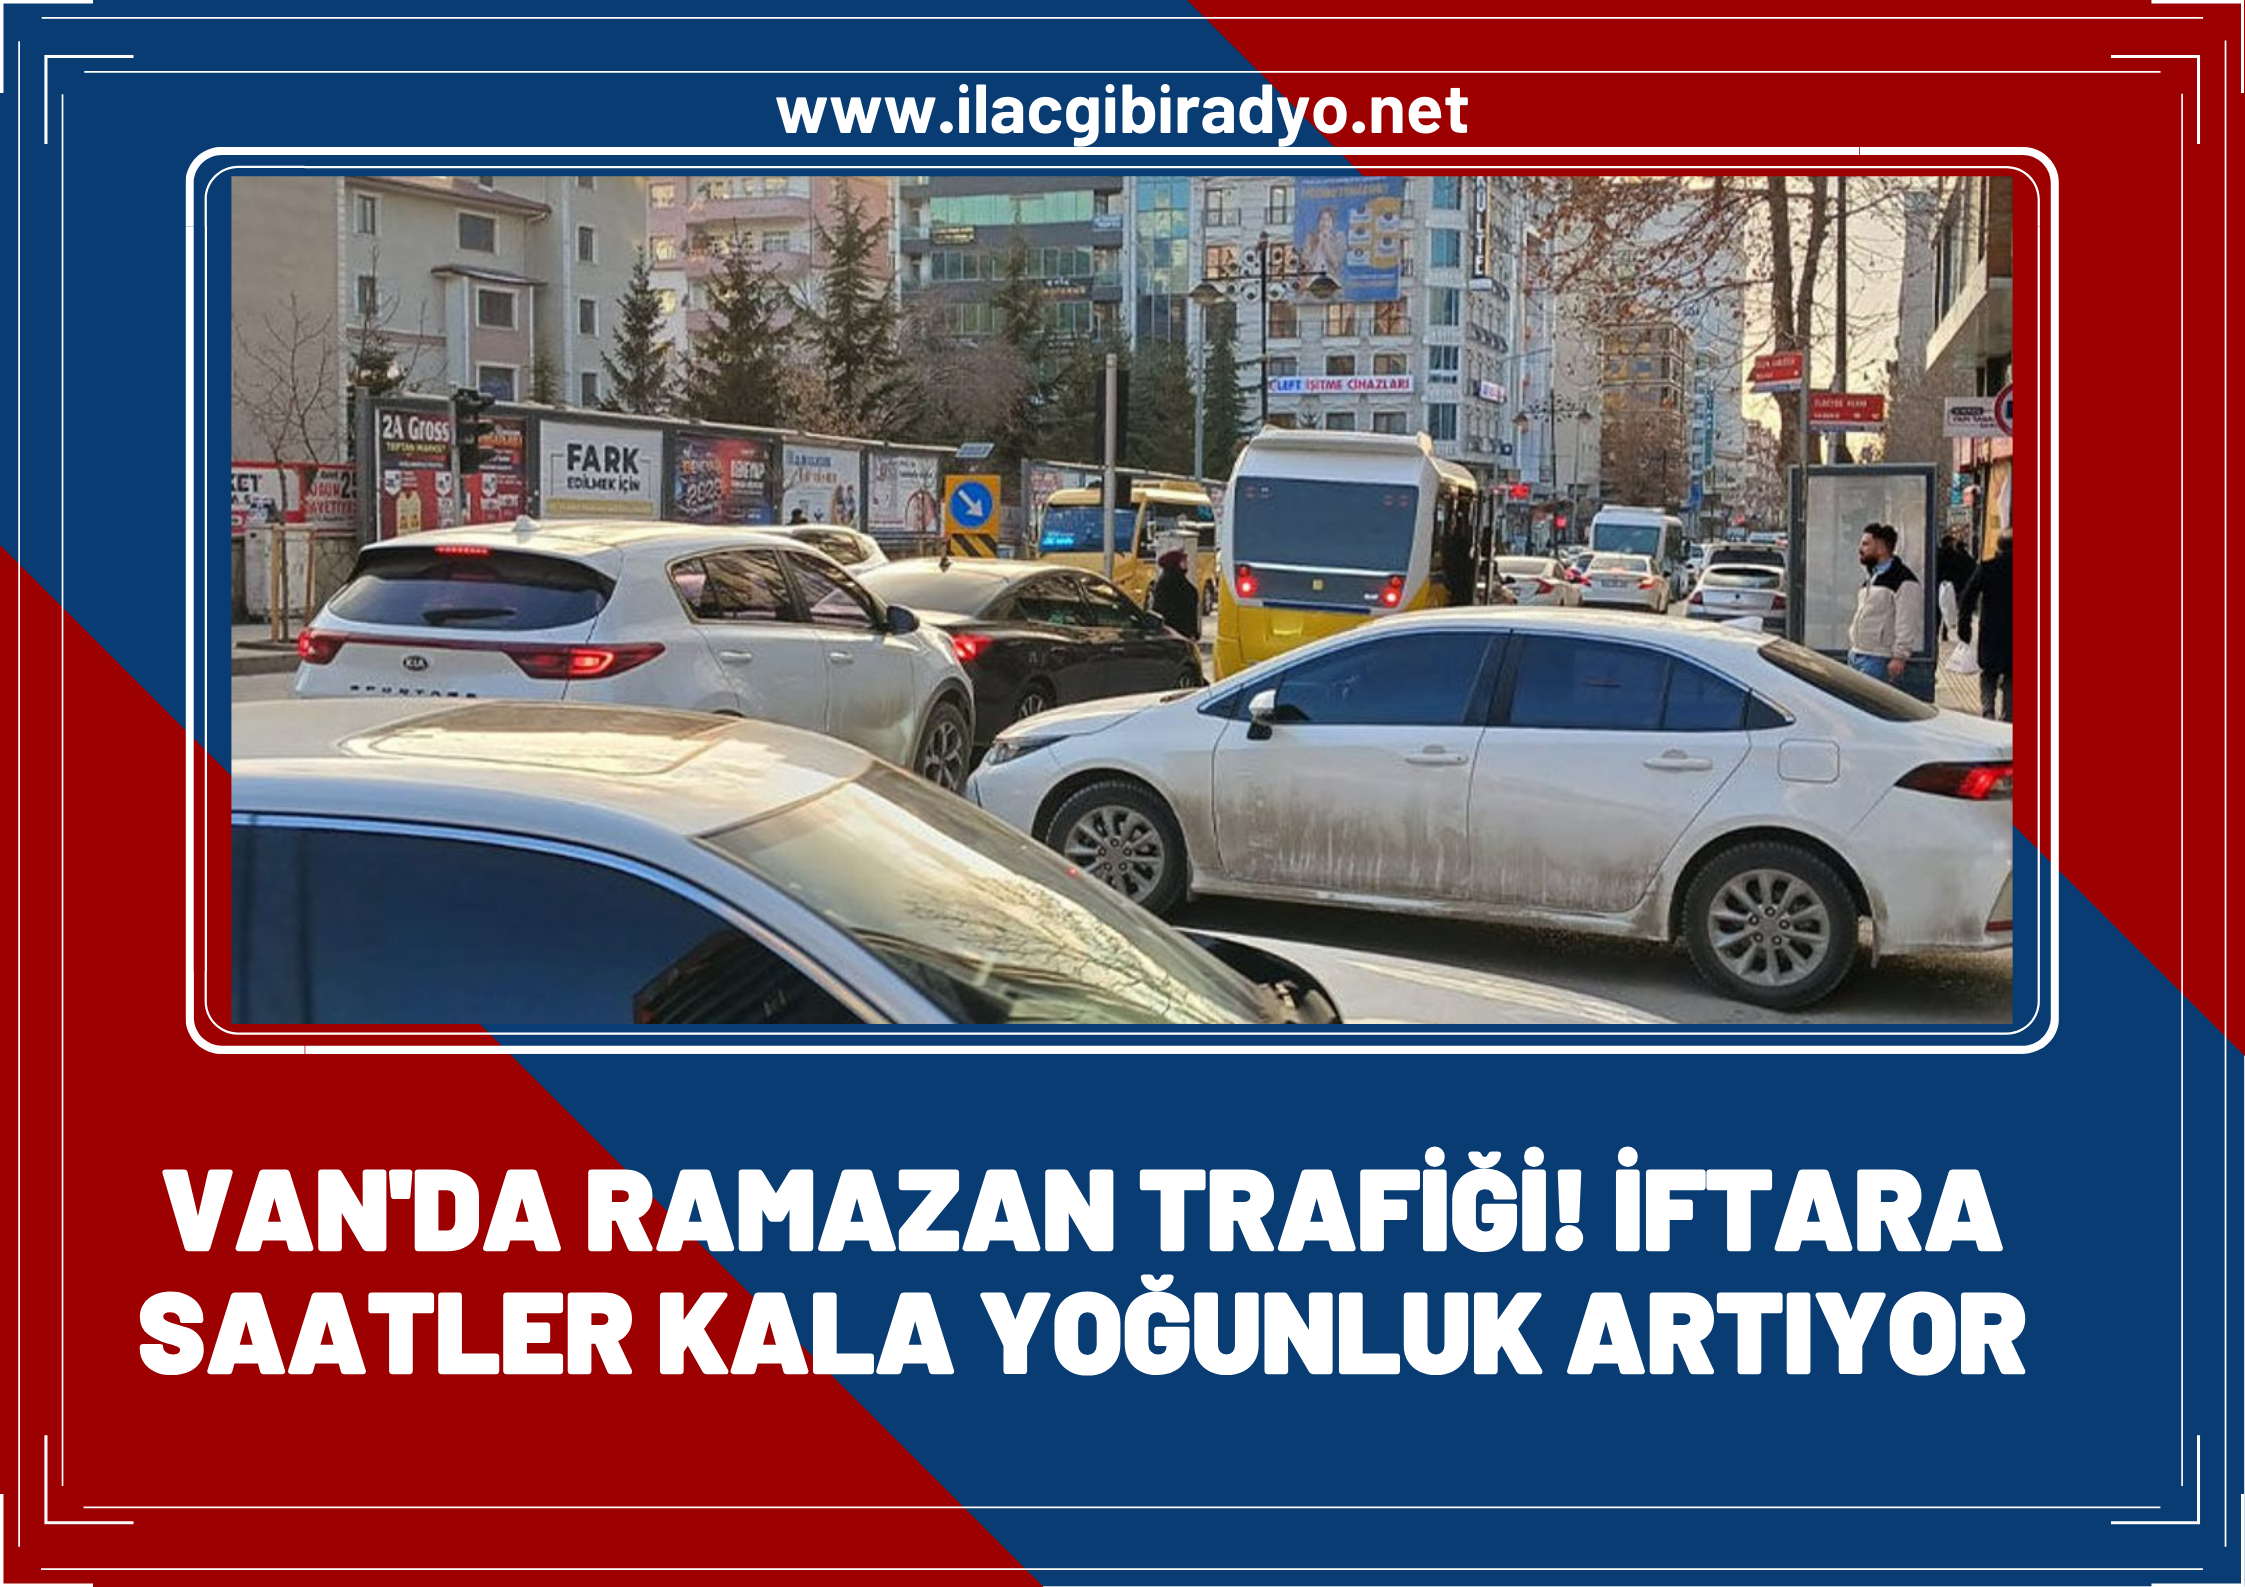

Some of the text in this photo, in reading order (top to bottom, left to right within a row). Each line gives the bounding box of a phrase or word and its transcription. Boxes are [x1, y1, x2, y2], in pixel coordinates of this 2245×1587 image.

[1306, 376, 1342, 391] İŞİTME
[1347, 376, 1410, 391] CİHAZLARI
[382, 414, 404, 440] 2A
[408, 415, 451, 442] Gross
[567, 443, 639, 474] FARK
[567, 474, 640, 494] EDİLMEK İÇİN
[404, 656, 428, 670] KIA
